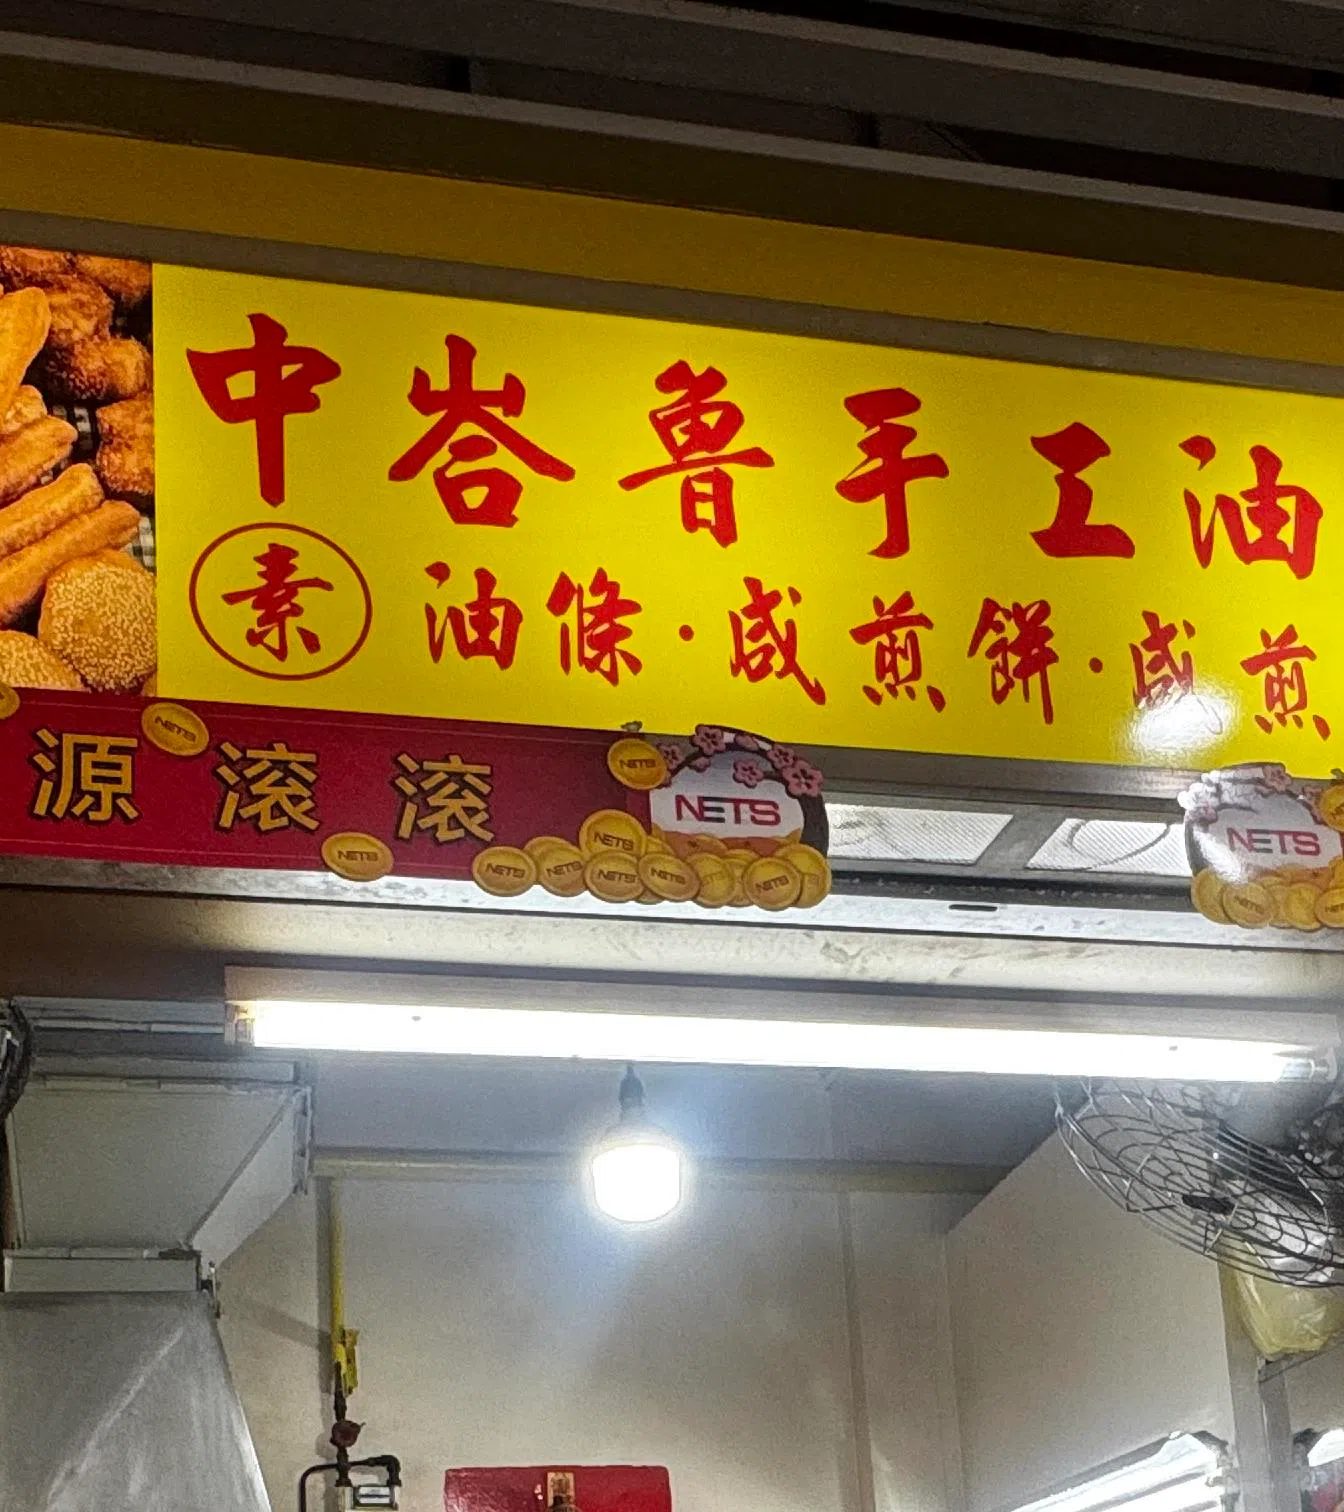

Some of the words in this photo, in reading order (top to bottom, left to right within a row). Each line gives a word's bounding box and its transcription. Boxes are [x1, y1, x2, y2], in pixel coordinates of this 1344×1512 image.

[220, 543, 335, 663] 素
[675, 795, 781, 826] NETS
[1226, 827, 1321, 857] NETS
